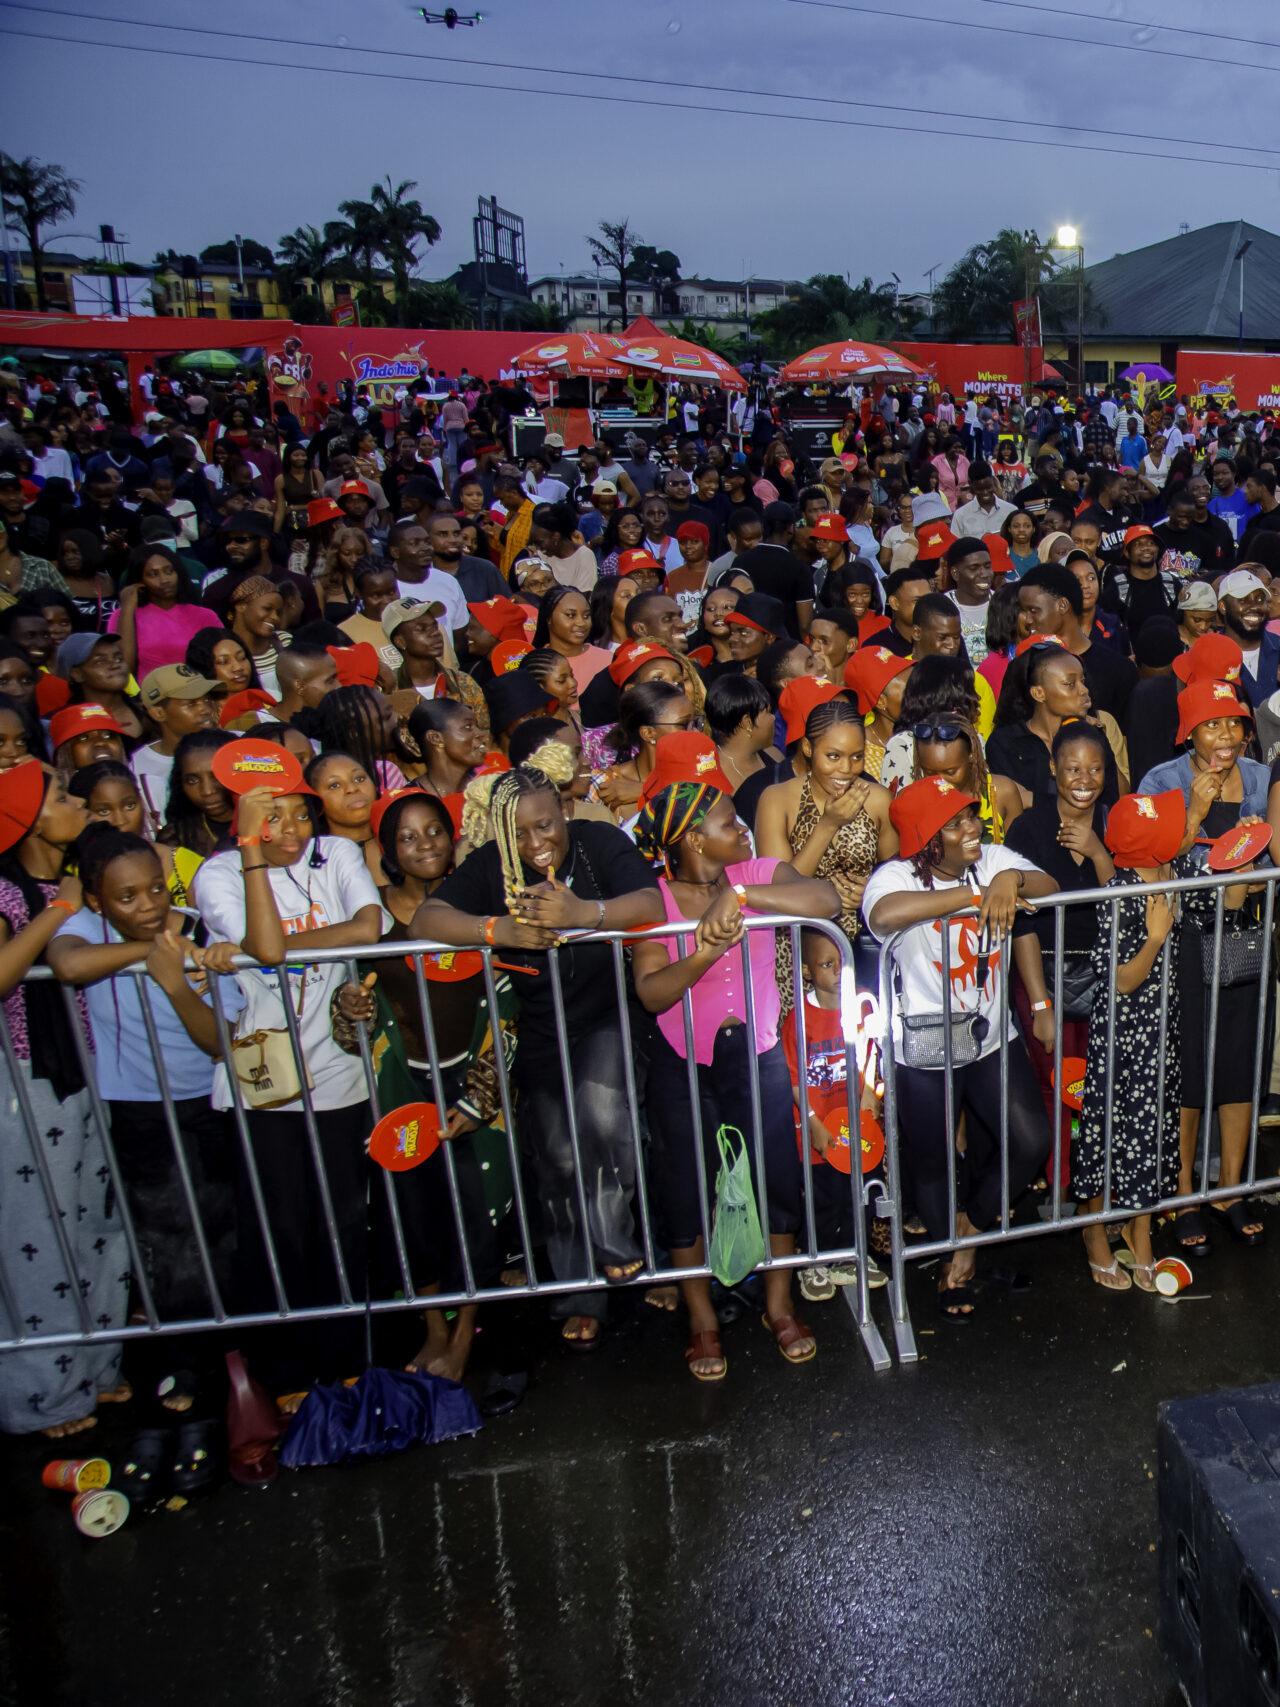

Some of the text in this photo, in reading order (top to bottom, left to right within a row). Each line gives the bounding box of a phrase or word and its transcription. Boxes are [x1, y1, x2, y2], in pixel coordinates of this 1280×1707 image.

[357, 357, 420, 384] Indomie
[978, 372, 1008, 382] Where
[964, 382, 1022, 397] MOMENTS
[233, 761, 285, 773] PALOOZA
[404, 1119, 419, 1158] PALOOZA
